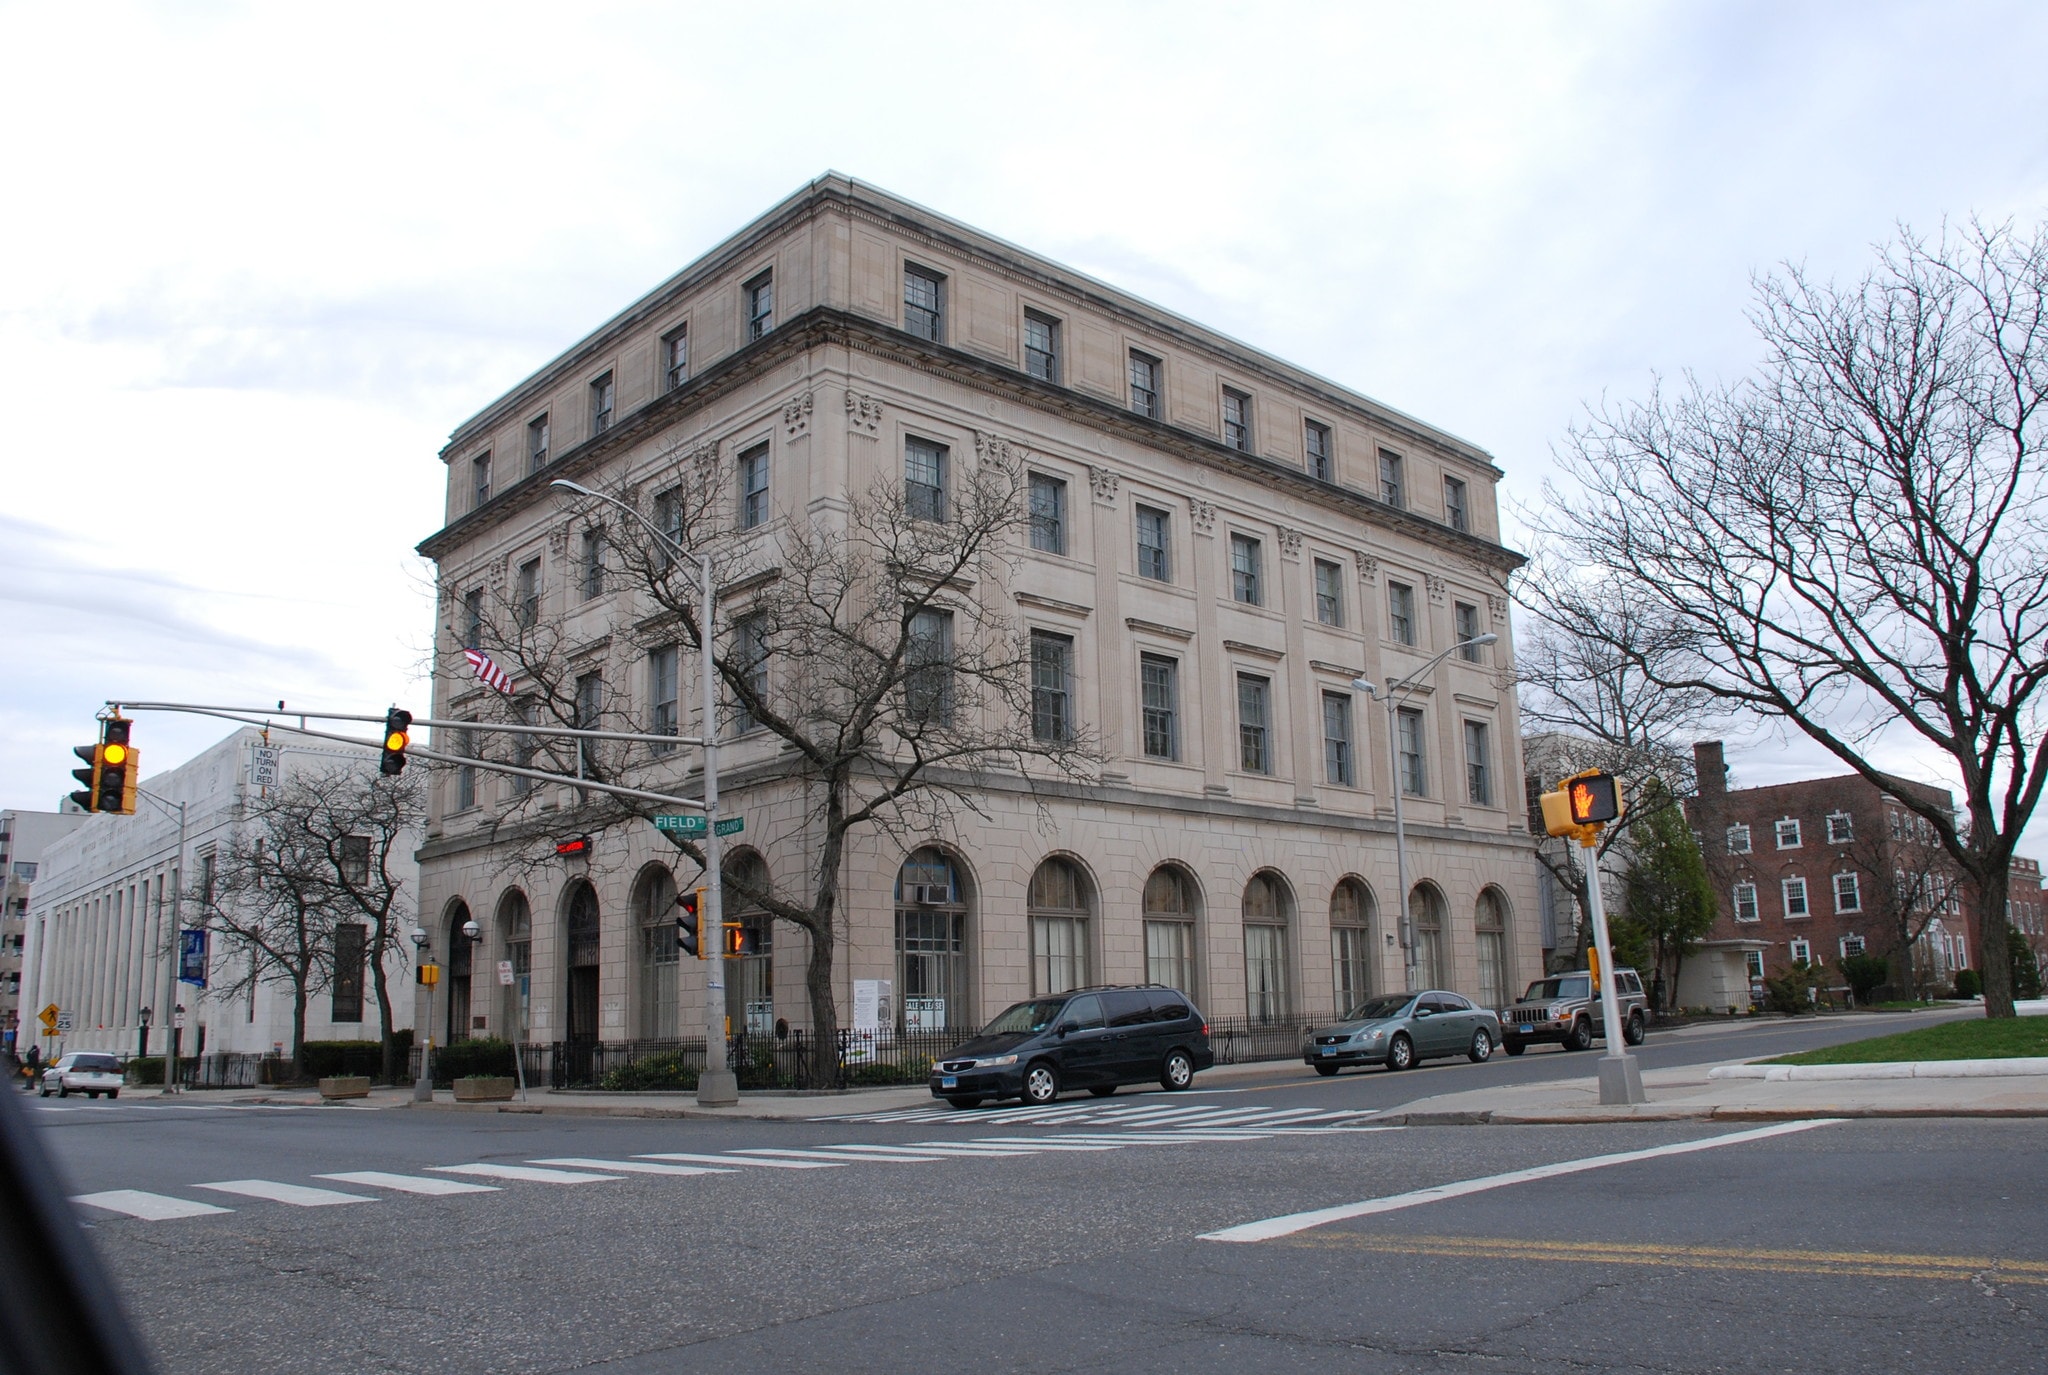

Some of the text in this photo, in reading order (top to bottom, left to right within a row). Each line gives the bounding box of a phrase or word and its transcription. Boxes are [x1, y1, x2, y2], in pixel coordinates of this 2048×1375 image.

[260, 750, 273, 759] NO
[256, 757, 277, 767] TURN
[259, 767, 272, 775] ON
[257, 775, 273, 784] RED
[656, 817, 696, 828] FIELD
[716, 820, 740, 835] GRAND
[58, 1020, 71, 1029] 25
